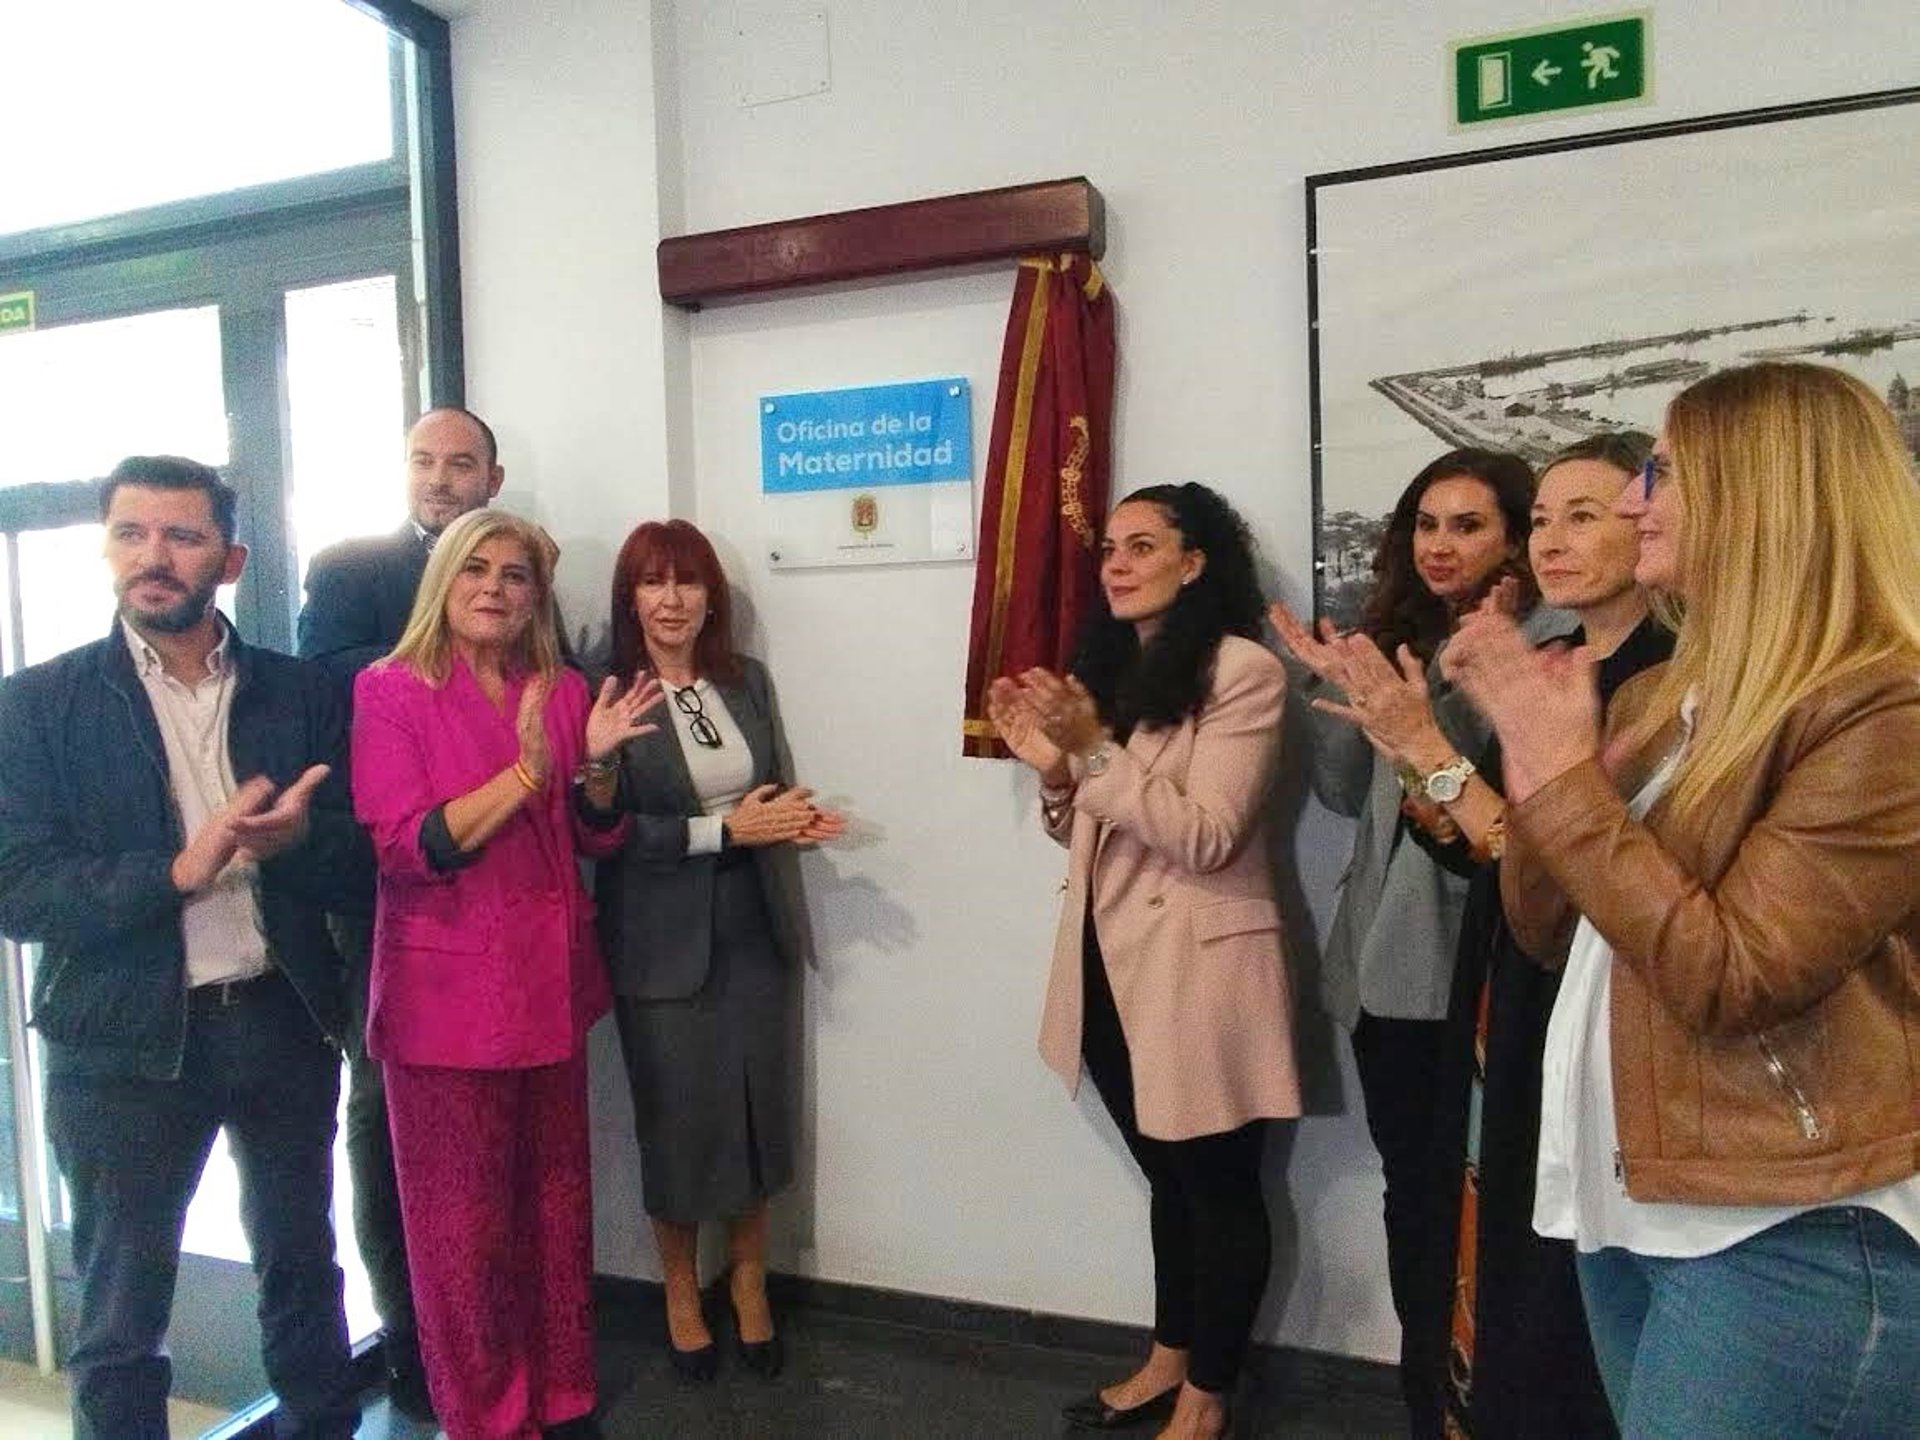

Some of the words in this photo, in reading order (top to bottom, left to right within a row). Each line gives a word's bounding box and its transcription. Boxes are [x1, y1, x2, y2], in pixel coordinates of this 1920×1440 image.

[777, 420, 864, 443] Oficina
[871, 413, 903, 434] de
[909, 411, 932, 432] la
[779, 439, 952, 477] Maternidad
